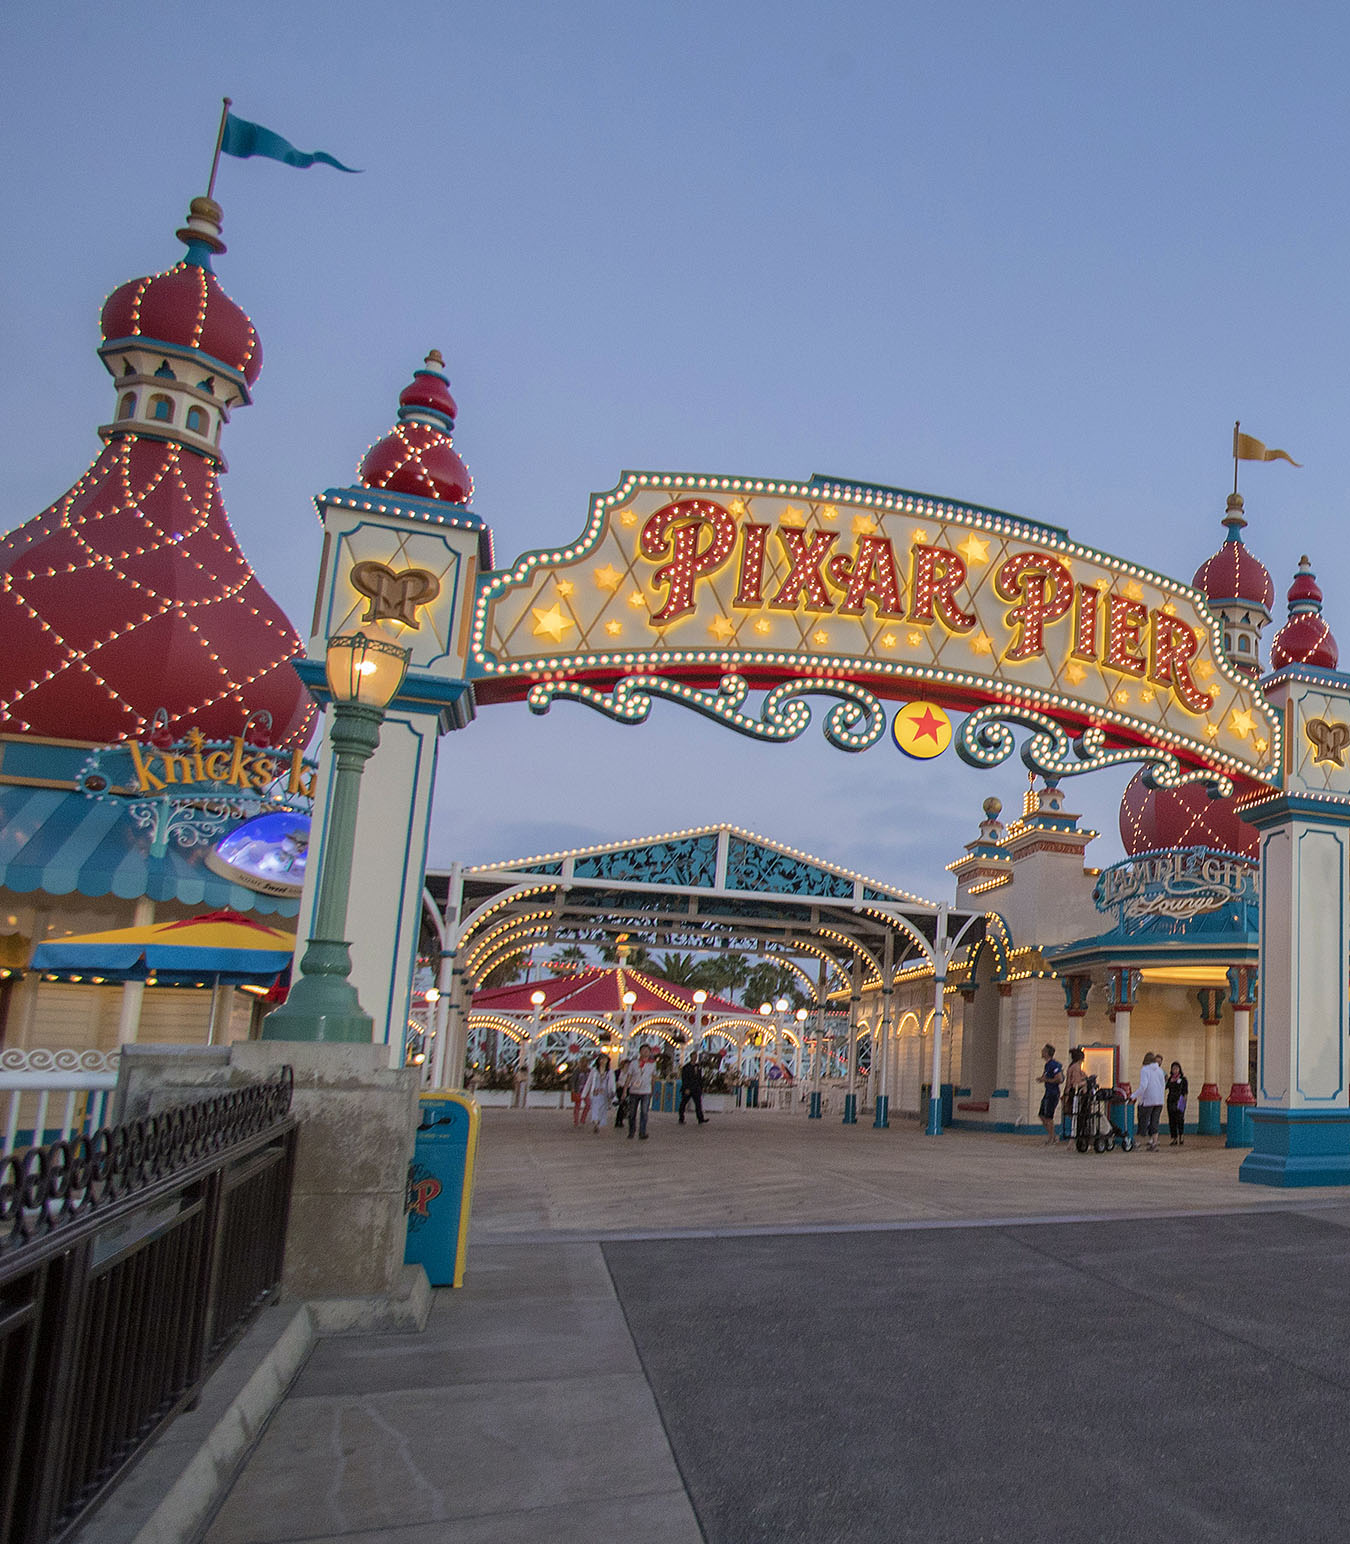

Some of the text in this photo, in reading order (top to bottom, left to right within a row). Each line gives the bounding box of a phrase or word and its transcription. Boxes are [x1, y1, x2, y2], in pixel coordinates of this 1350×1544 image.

[639, 498, 1214, 714] PIXAR PIER
[1127, 892, 1228, 919] Lounge
